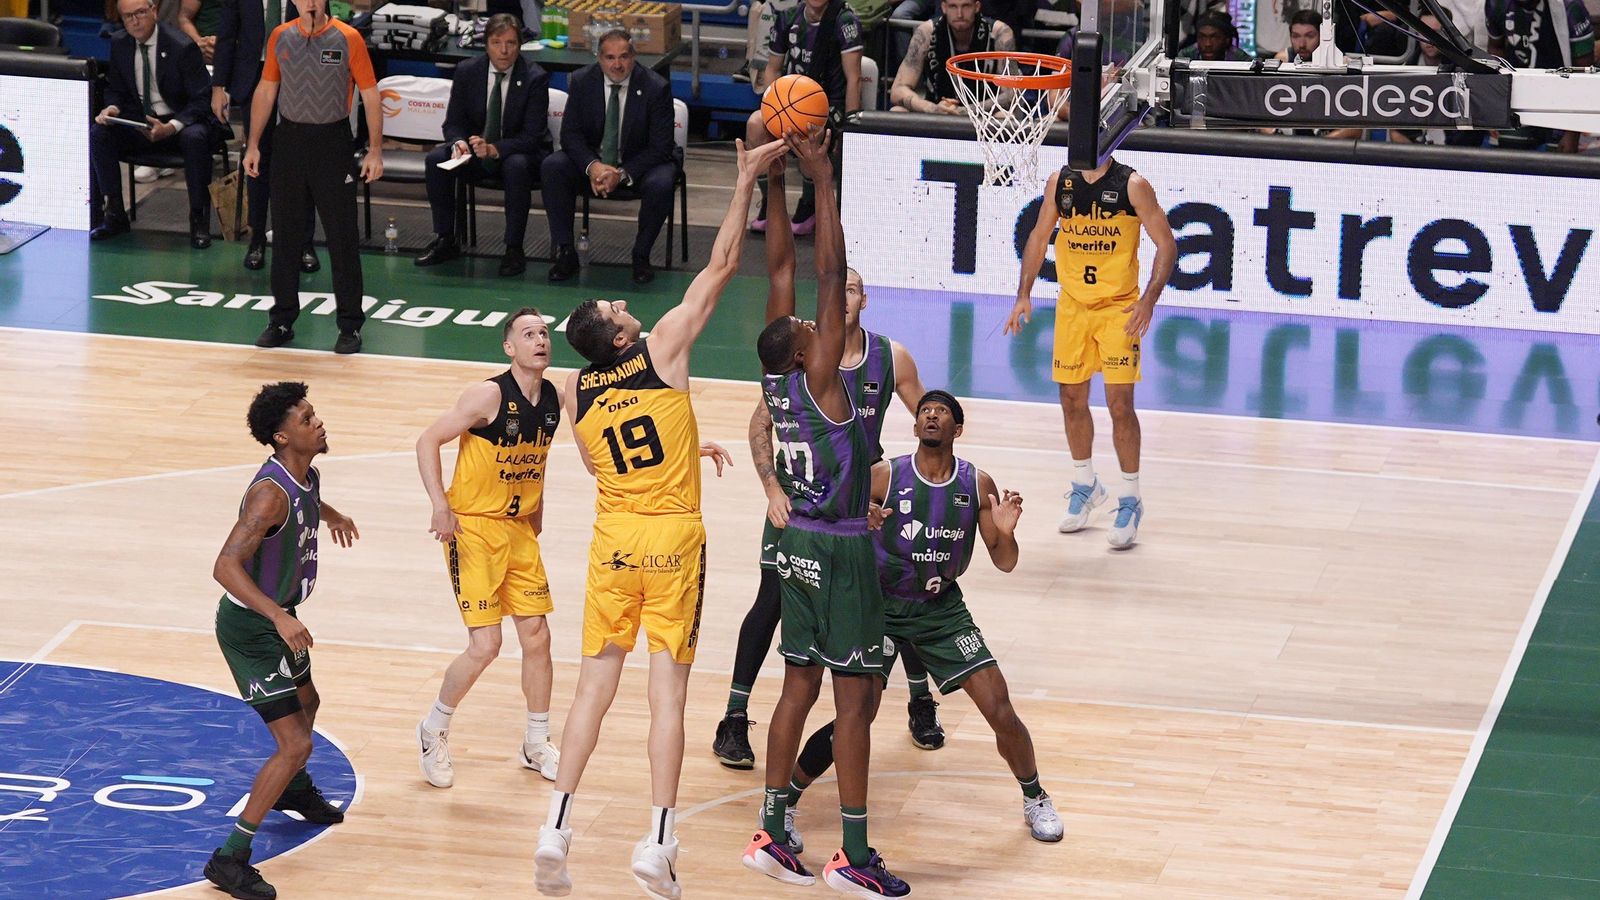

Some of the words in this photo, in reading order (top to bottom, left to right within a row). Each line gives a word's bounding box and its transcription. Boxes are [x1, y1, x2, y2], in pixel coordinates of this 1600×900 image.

[1265, 76, 1470, 118] endesa
[1075, 225, 1121, 236] LAGUNA
[1083, 265, 1097, 284] 6
[580, 353, 647, 390] SHERMADINI
[602, 415, 664, 475] 19
[925, 526, 964, 541] Unicaja
[642, 554, 682, 568] CICAR
[790, 555, 821, 571] COSTA
[803, 570, 821, 580] SOL
[925, 576, 942, 594] 6
